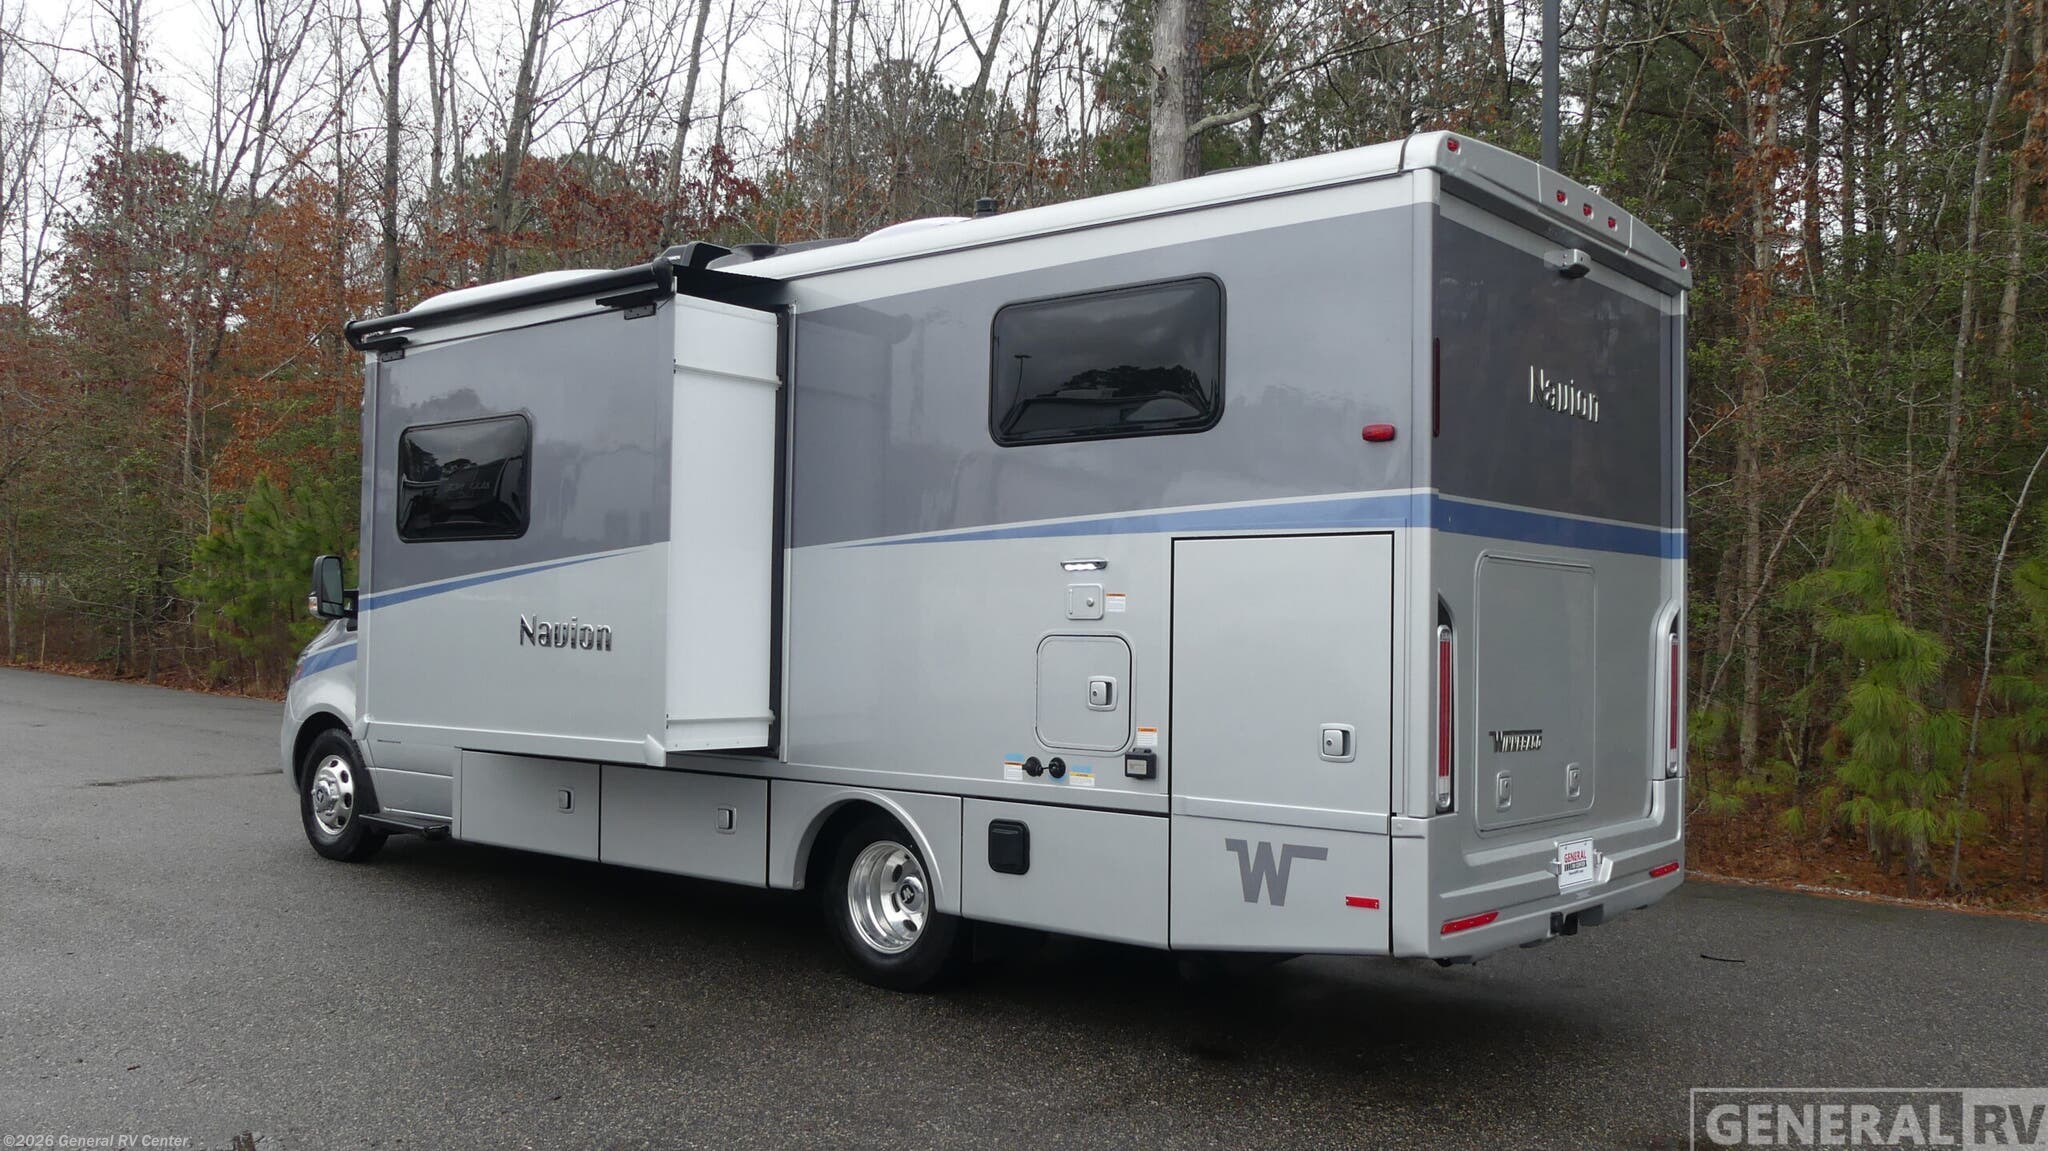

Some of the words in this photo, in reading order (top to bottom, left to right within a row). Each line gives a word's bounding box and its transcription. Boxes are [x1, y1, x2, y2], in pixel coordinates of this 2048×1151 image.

[1529, 365, 1599, 422] Navion
[520, 614, 612, 651] Navion
[1225, 838, 1328, 907] W
